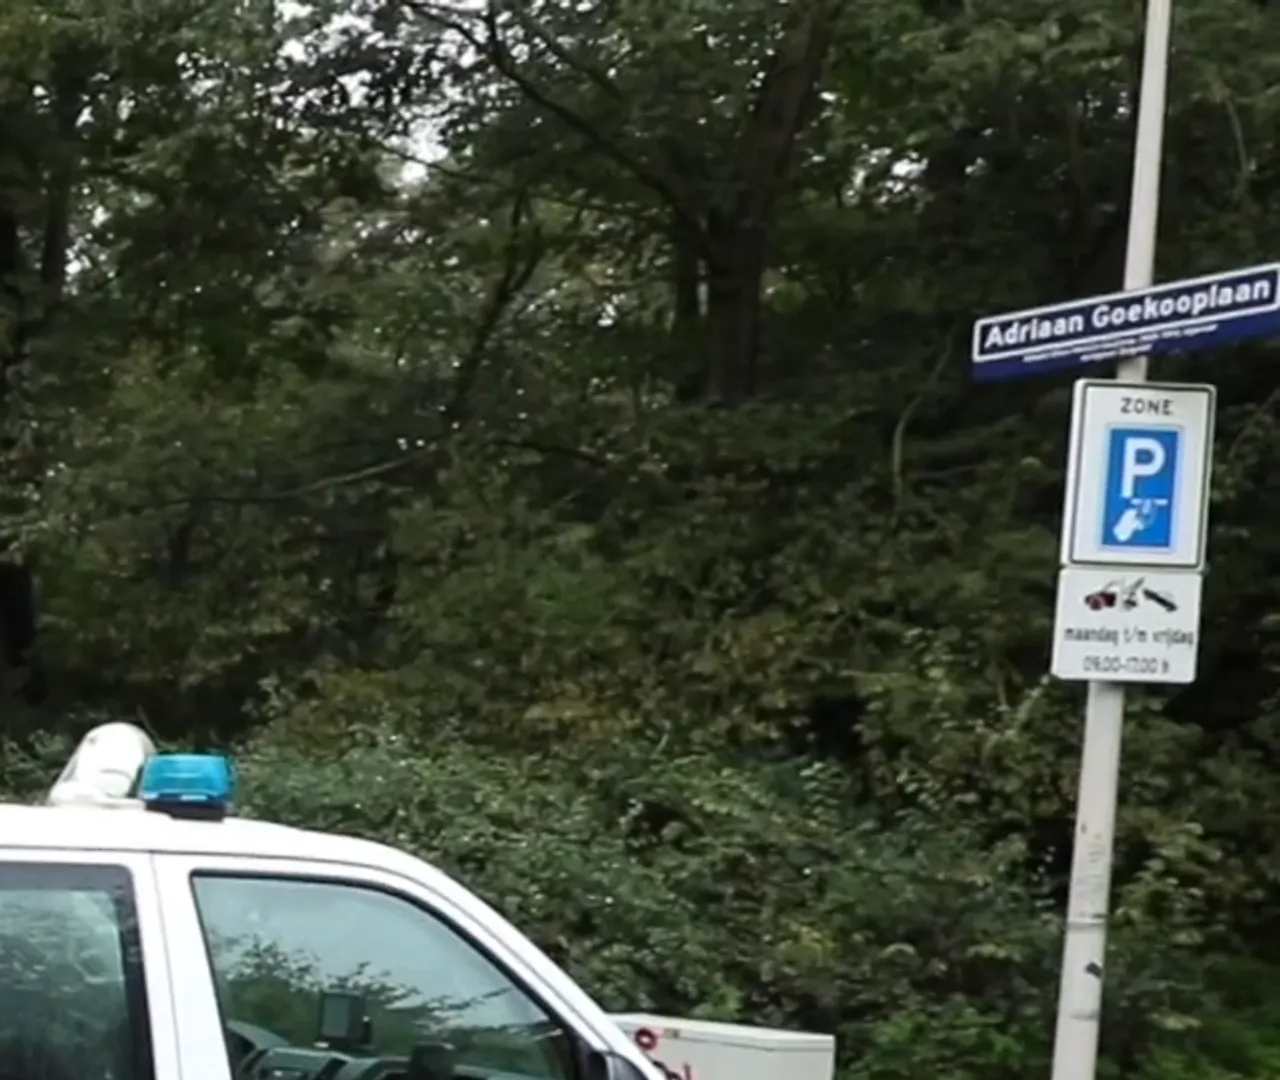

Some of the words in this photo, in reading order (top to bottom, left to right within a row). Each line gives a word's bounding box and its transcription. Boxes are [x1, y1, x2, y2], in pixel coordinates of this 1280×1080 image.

[985, 312, 1084, 348] Adriaan
[1091, 279, 1270, 330] Goekooplaan
[1120, 398, 1174, 416] ZONE
[1122, 437, 1166, 499] P
[1064, 627, 1119, 647] maandag
